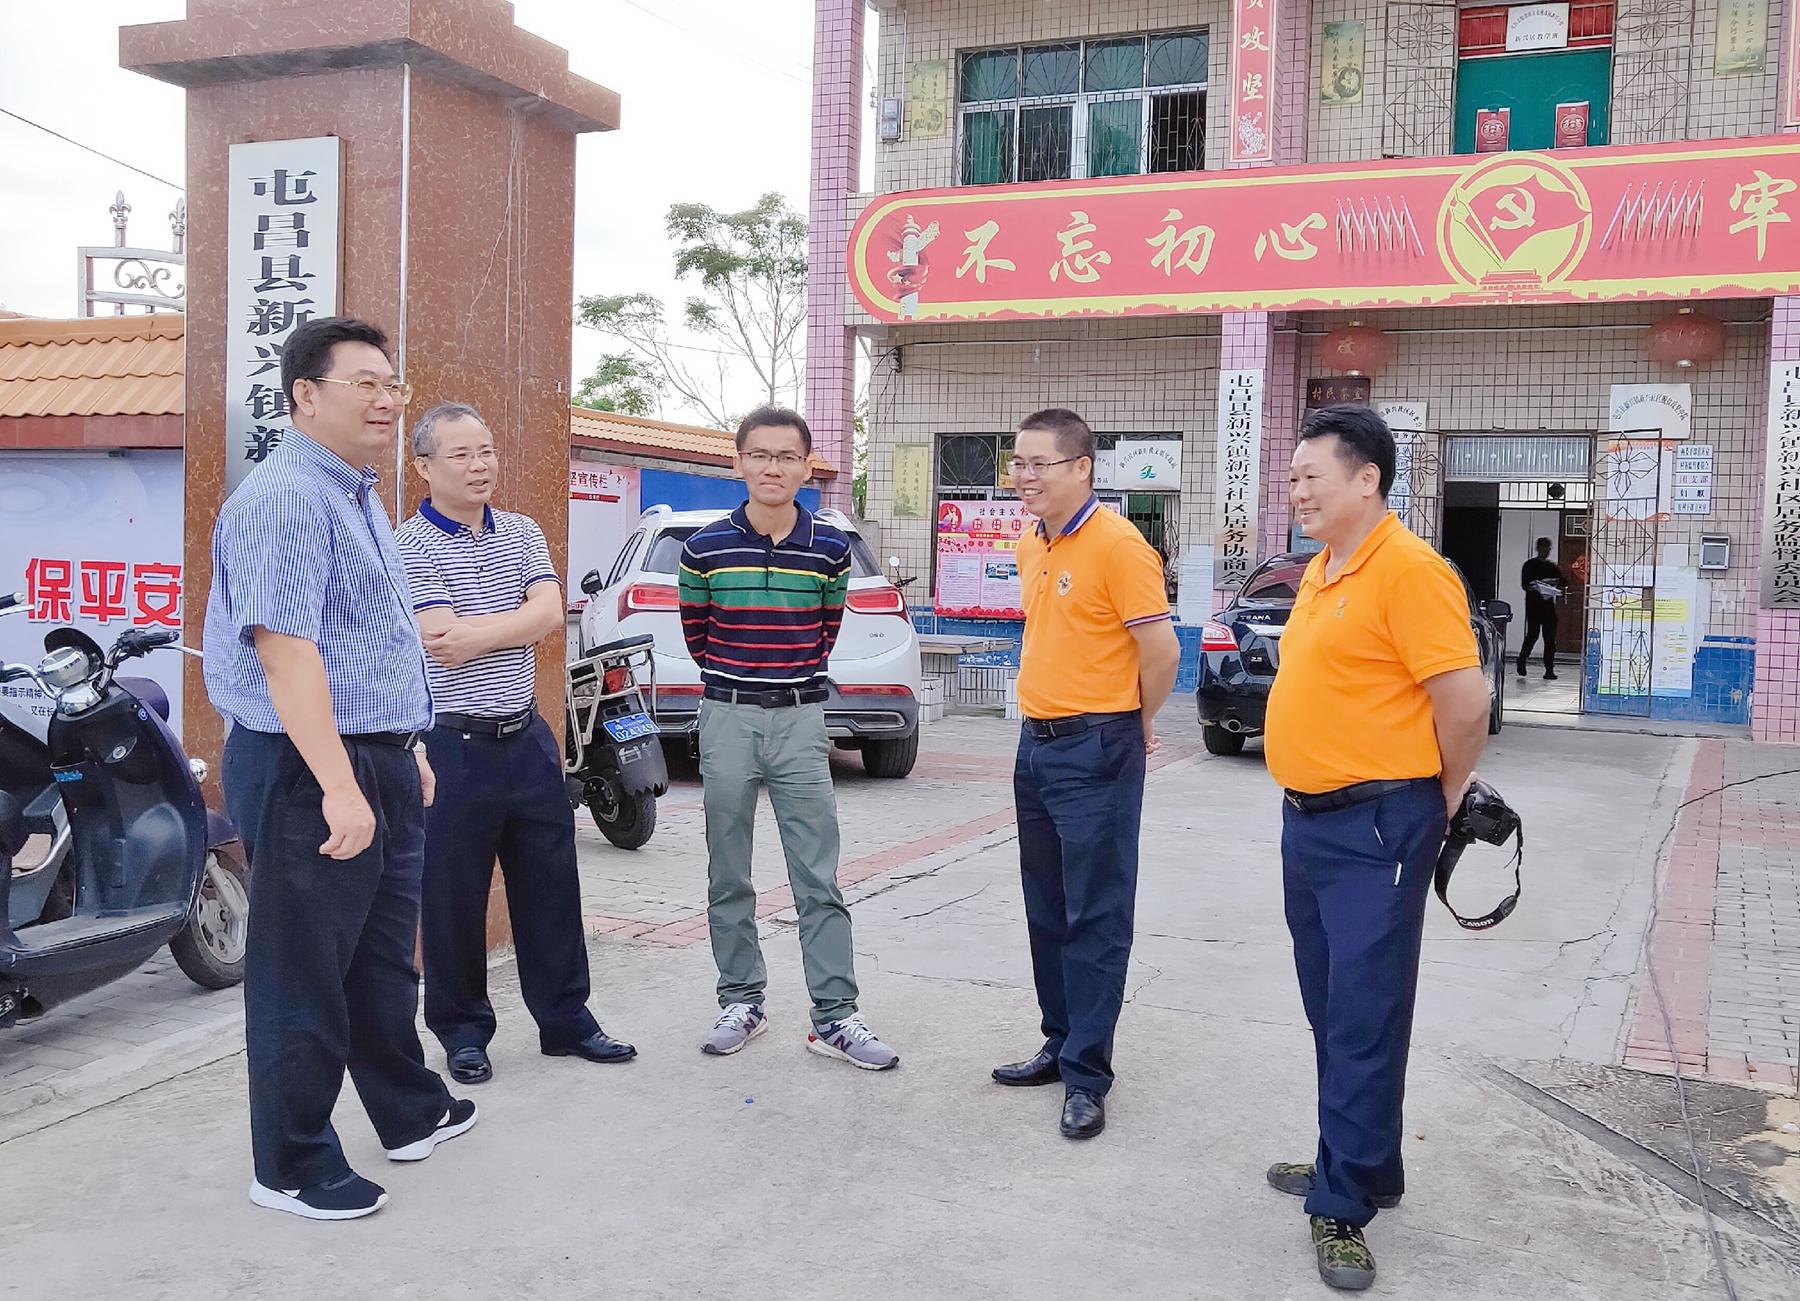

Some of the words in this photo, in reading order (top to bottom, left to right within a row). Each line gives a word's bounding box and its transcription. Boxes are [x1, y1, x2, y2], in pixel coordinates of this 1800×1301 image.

[956, 208, 1328, 285] 不忘初心
[1729, 170, 1799, 262] 牢
[1312, 386, 1364, 401] 村民茶室
[1222, 374, 1254, 585] 屯昌县新兴镇新兴社区居务协商会
[25, 557, 182, 626] 保平安
[1459, 917, 1494, 928] Canon
